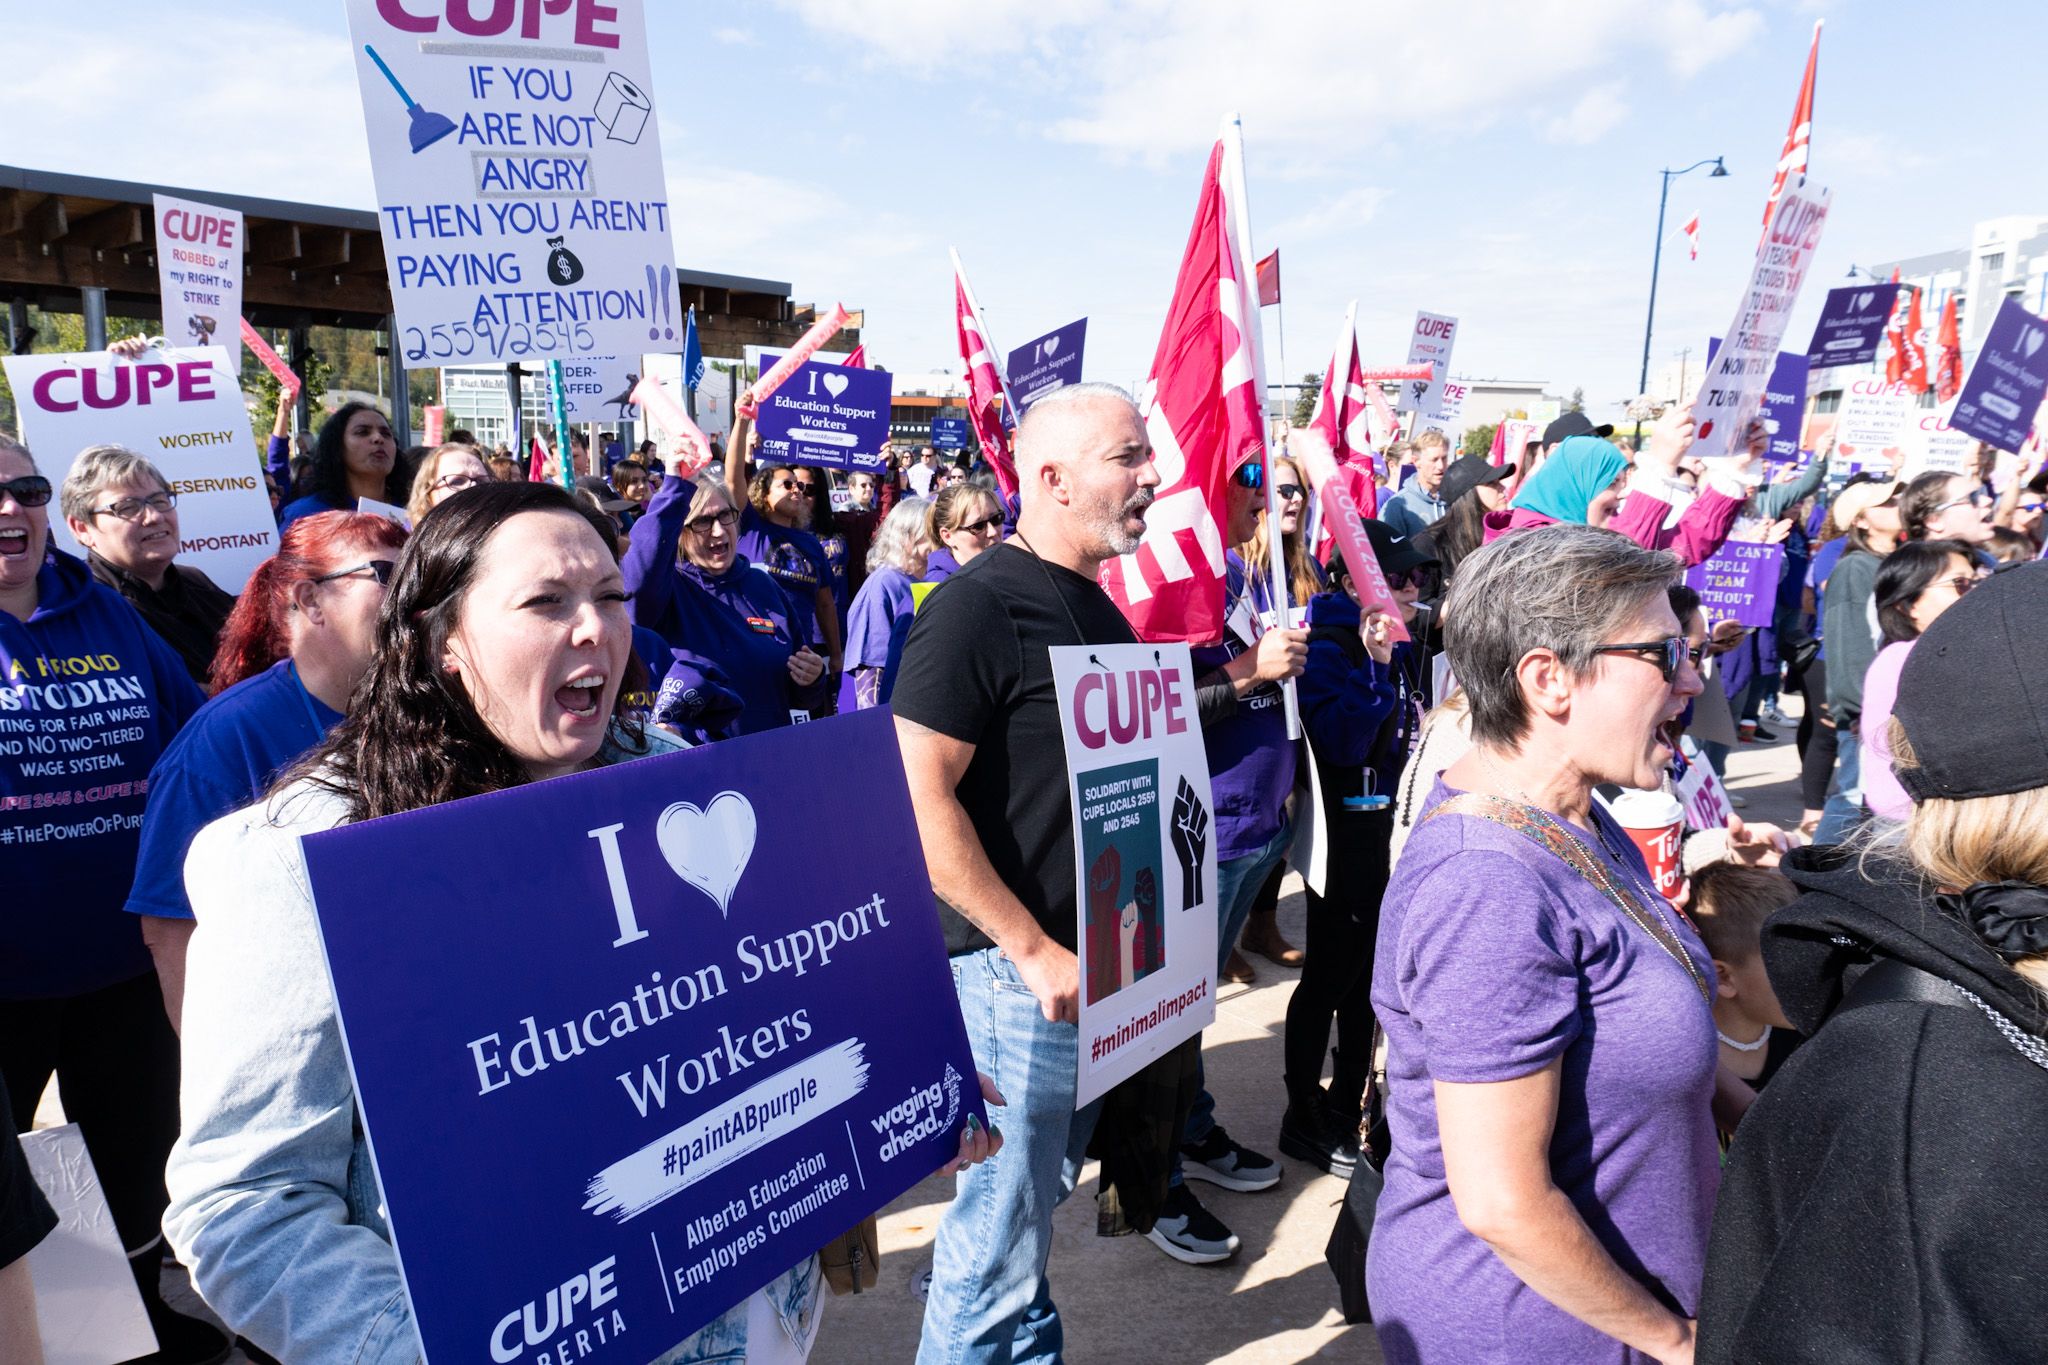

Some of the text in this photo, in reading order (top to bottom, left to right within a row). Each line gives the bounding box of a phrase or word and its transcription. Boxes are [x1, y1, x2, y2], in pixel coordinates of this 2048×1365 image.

[468, 65, 573, 102] IF YOU
[457, 112, 596, 148] ARE NOT
[481, 158, 588, 190] ANGRY
[163, 209, 235, 248] CUPE
[383, 199, 667, 240] THEN YOU AREN'T
[1771, 194, 1827, 250] CUPE
[173, 249, 229, 269] ROBBED of
[397, 253, 521, 288] PAYING
[170, 272, 233, 289] my RIGHT to
[183, 291, 220, 306] STRIKE
[1846, 293, 1858, 314] I
[1416, 317, 1454, 339] CUPE
[1034, 343, 1042, 365] I
[1014, 352, 1076, 387] Education Support
[1028, 373, 1057, 390] Workers
[33, 360, 215, 412] CUPE
[546, 384, 603, 395] SAFFED
[808, 371, 818, 395] I
[547, 401, 578, 412] TO.
[775, 395, 876, 419] Education Support
[1707, 389, 1742, 407] TURN
[1767, 392, 1795, 404] upport
[800, 414, 847, 431] Workers
[159, 431, 234, 449] WORTHY
[763, 439, 790, 451] CUPE
[763, 448, 788, 457] ALBERTA
[168, 476, 256, 496] ESERVING
[178, 531, 270, 554] IMPORTANT
[1333, 484, 1393, 600] LOCAL 2545
[1735, 546, 1776, 559] CAN'T
[1704, 560, 1750, 574] SPELL
[1706, 575, 1746, 588] TEAM
[10, 654, 121, 681] A PROUD
[40, 718, 67, 733] FOR
[69, 712, 105, 730] FAIR
[106, 705, 151, 723] WAGES
[1073, 668, 1187, 750] CUPE
[27, 735, 56, 754] NO
[59, 726, 145, 753] TWO-TIERED
[20, 752, 125, 777] WAGE SYSTEM.
[74, 790, 85, 804] &
[85, 781, 133, 802] CUPE
[1085, 775, 1152, 801] SOLIDARITY WITH
[1082, 791, 1156, 821] CUPE LOCALS 2559
[1103, 812, 1140, 834] AND 2545
[587, 822, 650, 949] I
[466, 893, 890, 1097] Education Support
[1092, 976, 1207, 1063] #minimalimpact
[616, 1009, 813, 1120] Workers
[871, 1080, 944, 1134] waging
[662, 1075, 817, 1178] #paintABpurple
[879, 1107, 944, 1163] ahead.
[686, 1151, 827, 1249] Alberta Education
[673, 1173, 850, 1296] Employees Committee
[488, 1255, 617, 1365] CUPE
